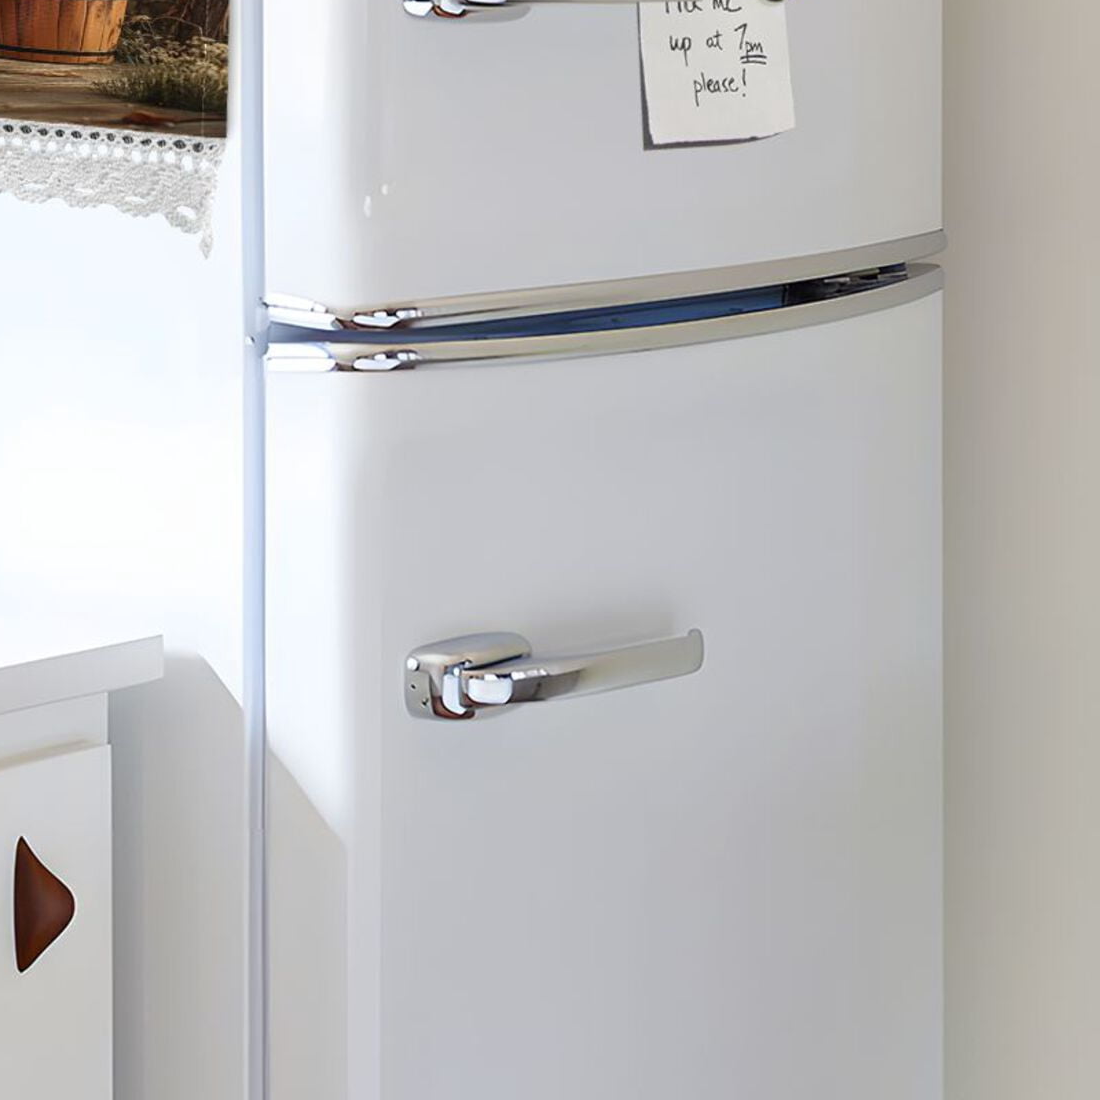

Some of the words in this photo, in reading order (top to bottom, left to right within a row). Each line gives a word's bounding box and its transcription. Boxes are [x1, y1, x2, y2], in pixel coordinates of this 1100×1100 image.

[669, 35, 692, 67] up
[706, 30, 723, 51] at
[693, 68, 747, 107] please!
